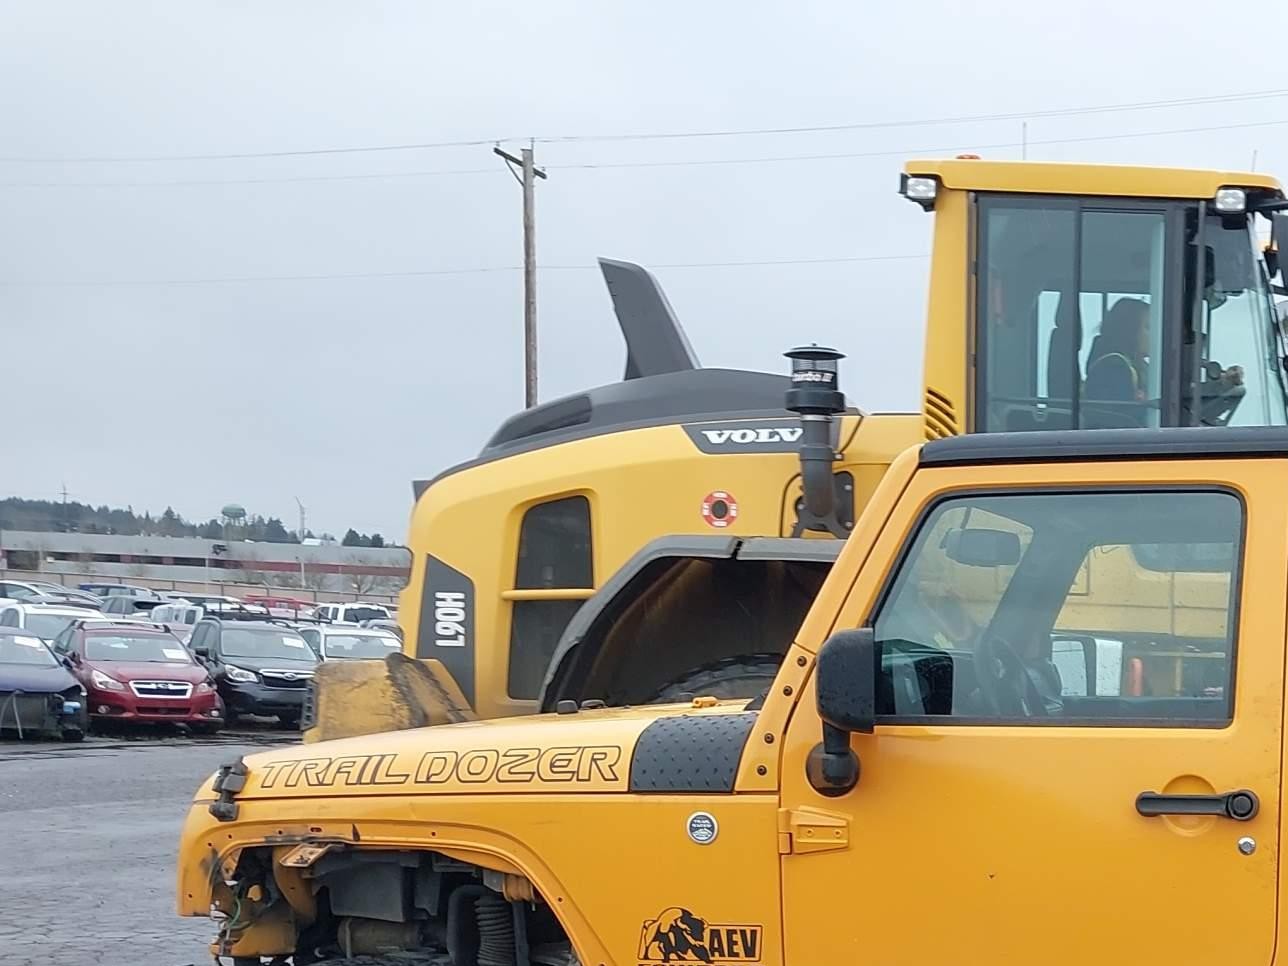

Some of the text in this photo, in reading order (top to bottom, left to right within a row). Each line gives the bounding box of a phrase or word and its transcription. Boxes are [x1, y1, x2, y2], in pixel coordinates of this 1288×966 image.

[701, 427, 804, 444] VOLV
[434, 591, 466, 647] L90H
[260, 745, 622, 789] TRAIL DOZER
[708, 928, 758, 958] AEV
